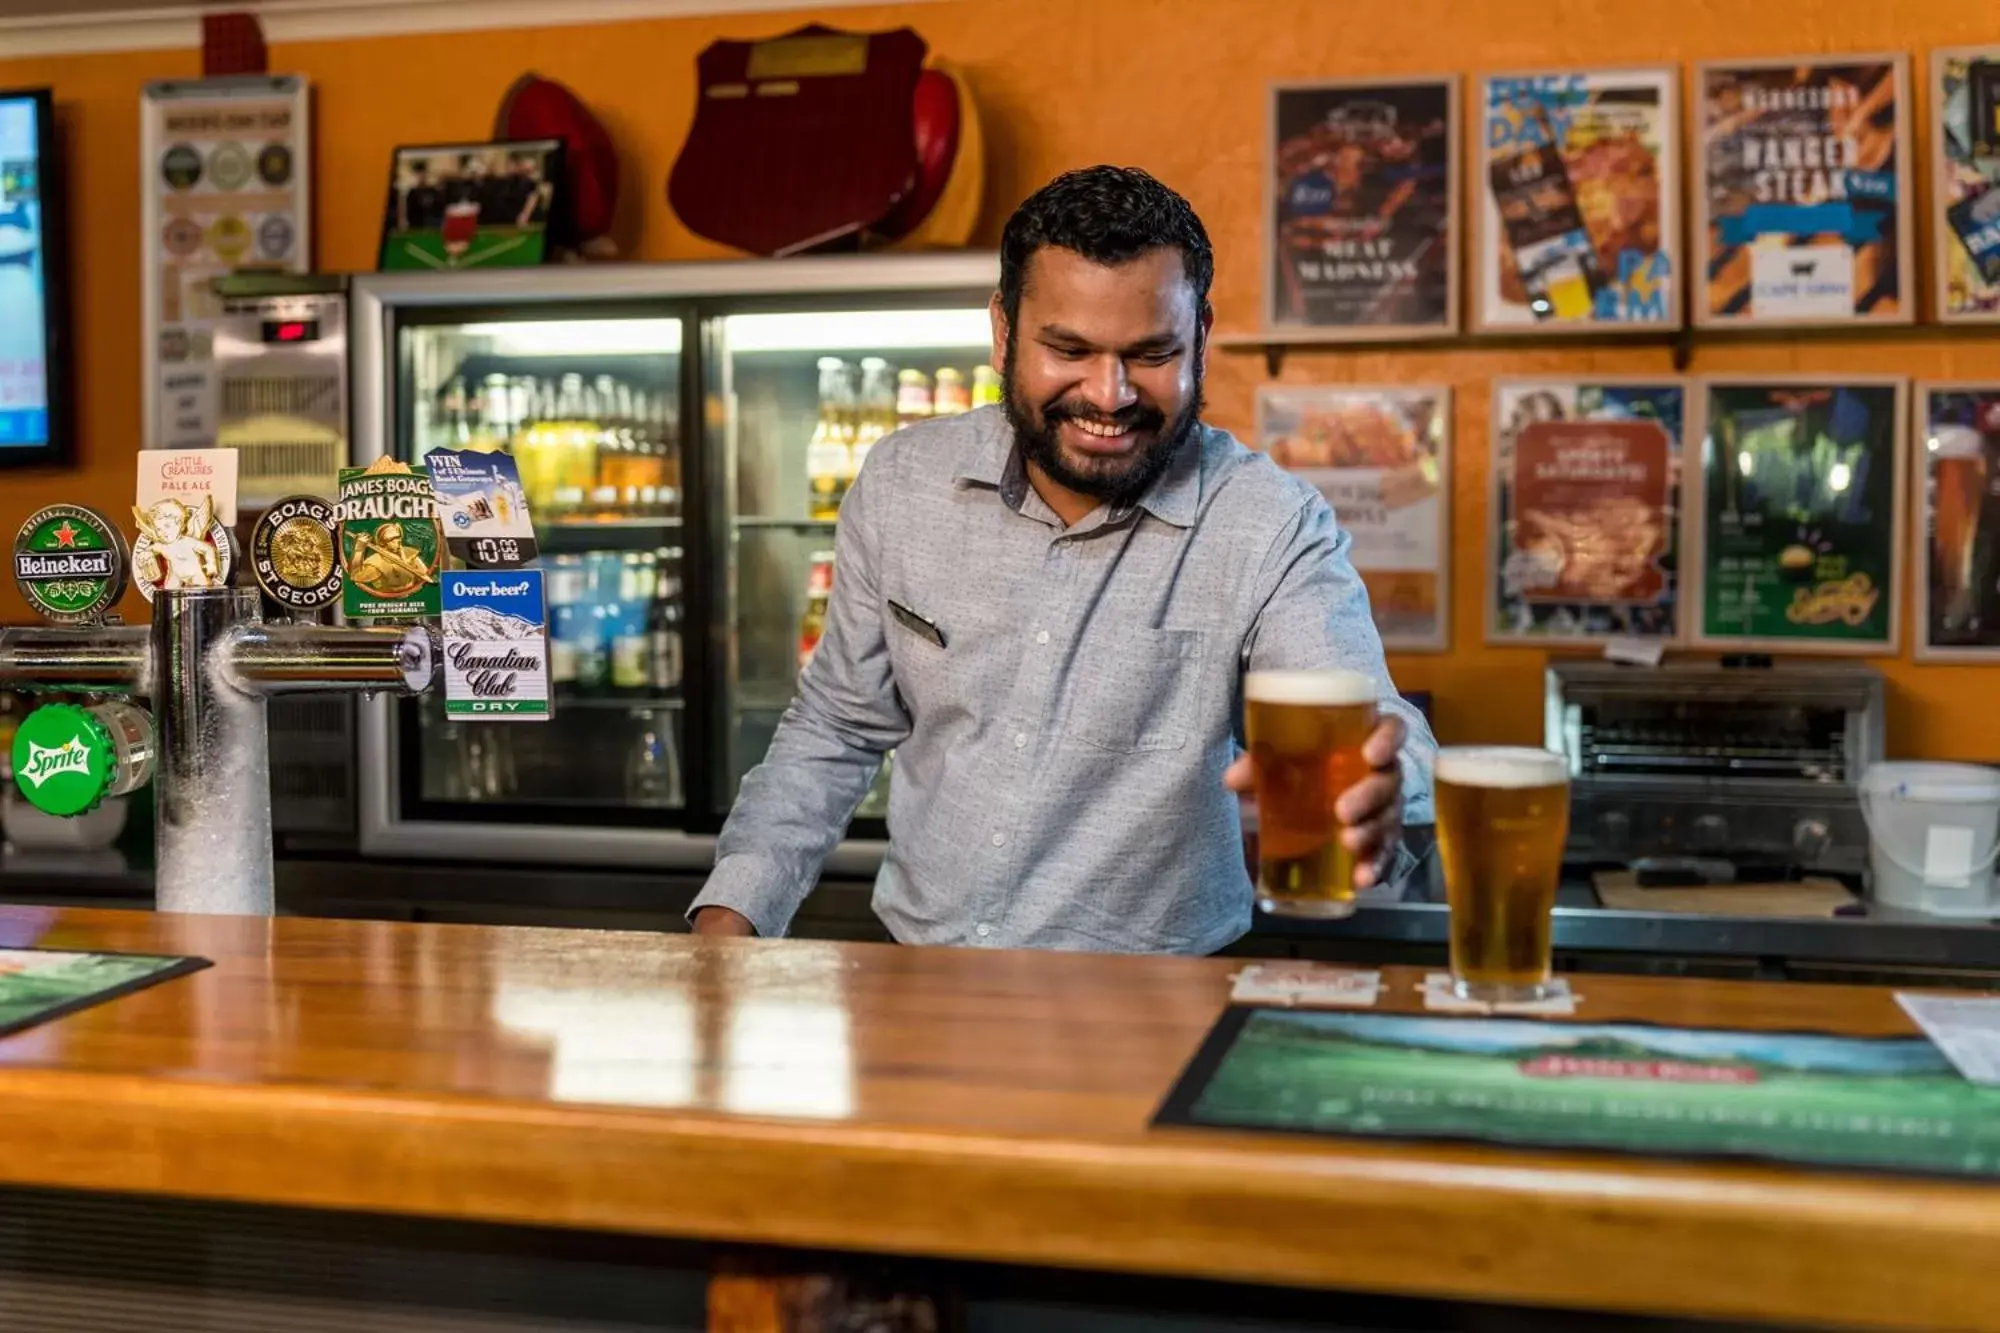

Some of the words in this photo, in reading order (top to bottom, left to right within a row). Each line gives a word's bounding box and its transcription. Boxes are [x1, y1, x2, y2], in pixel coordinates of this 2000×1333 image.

[160, 462, 214, 480] CREATURES
[174, 456, 202, 466] LITTLE
[427, 455, 462, 468] WIN
[161, 481, 188, 491] PALE
[191, 480, 212, 490] ALE
[339, 479, 384, 501] JAMES
[268, 501, 337, 531] BOAG'S
[332, 495, 441, 522] DRAUGHT
[19, 555, 107, 575] Heineken
[258, 559, 279, 584] ST
[452, 581, 490, 597] Over
[490, 581, 530, 597] beer?
[447, 642, 542, 672] Canadian
[466, 670, 518, 697] Club
[472, 702, 520, 711] DRY
[28, 746, 85, 777] Sprite
